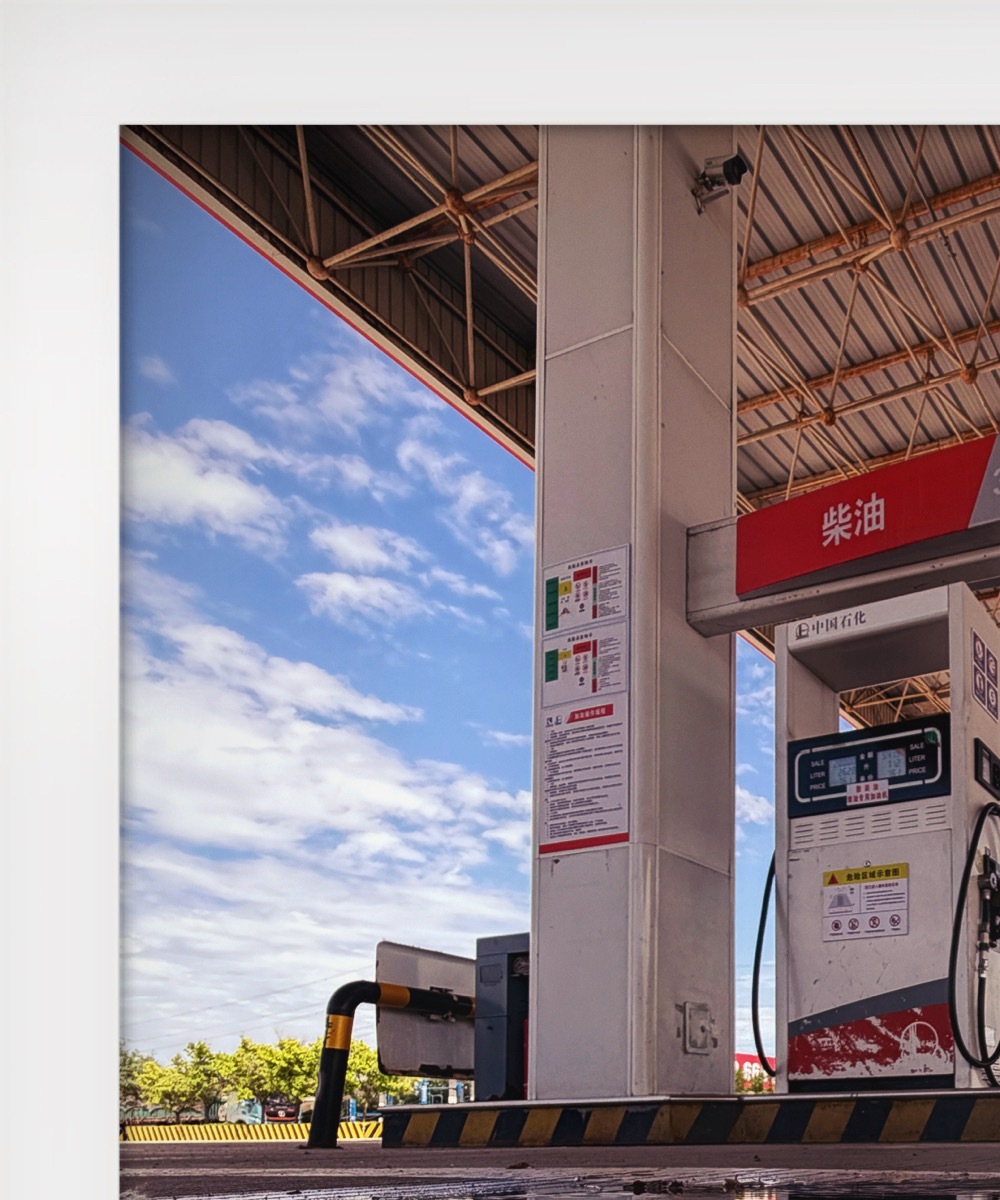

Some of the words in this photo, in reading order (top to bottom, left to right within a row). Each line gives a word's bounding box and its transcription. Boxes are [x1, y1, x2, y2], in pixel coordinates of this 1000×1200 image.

[822, 492, 885, 547] 柴油
[812, 610, 867, 634] 中国石化
[910, 742, 925, 750] SALE
[908, 755, 926, 763] LITER
[909, 766, 927, 774] PRICE
[810, 771, 826, 779] LITER
[810, 782, 827, 790] PRICE
[846, 868, 900, 881] 危险区域示意图
